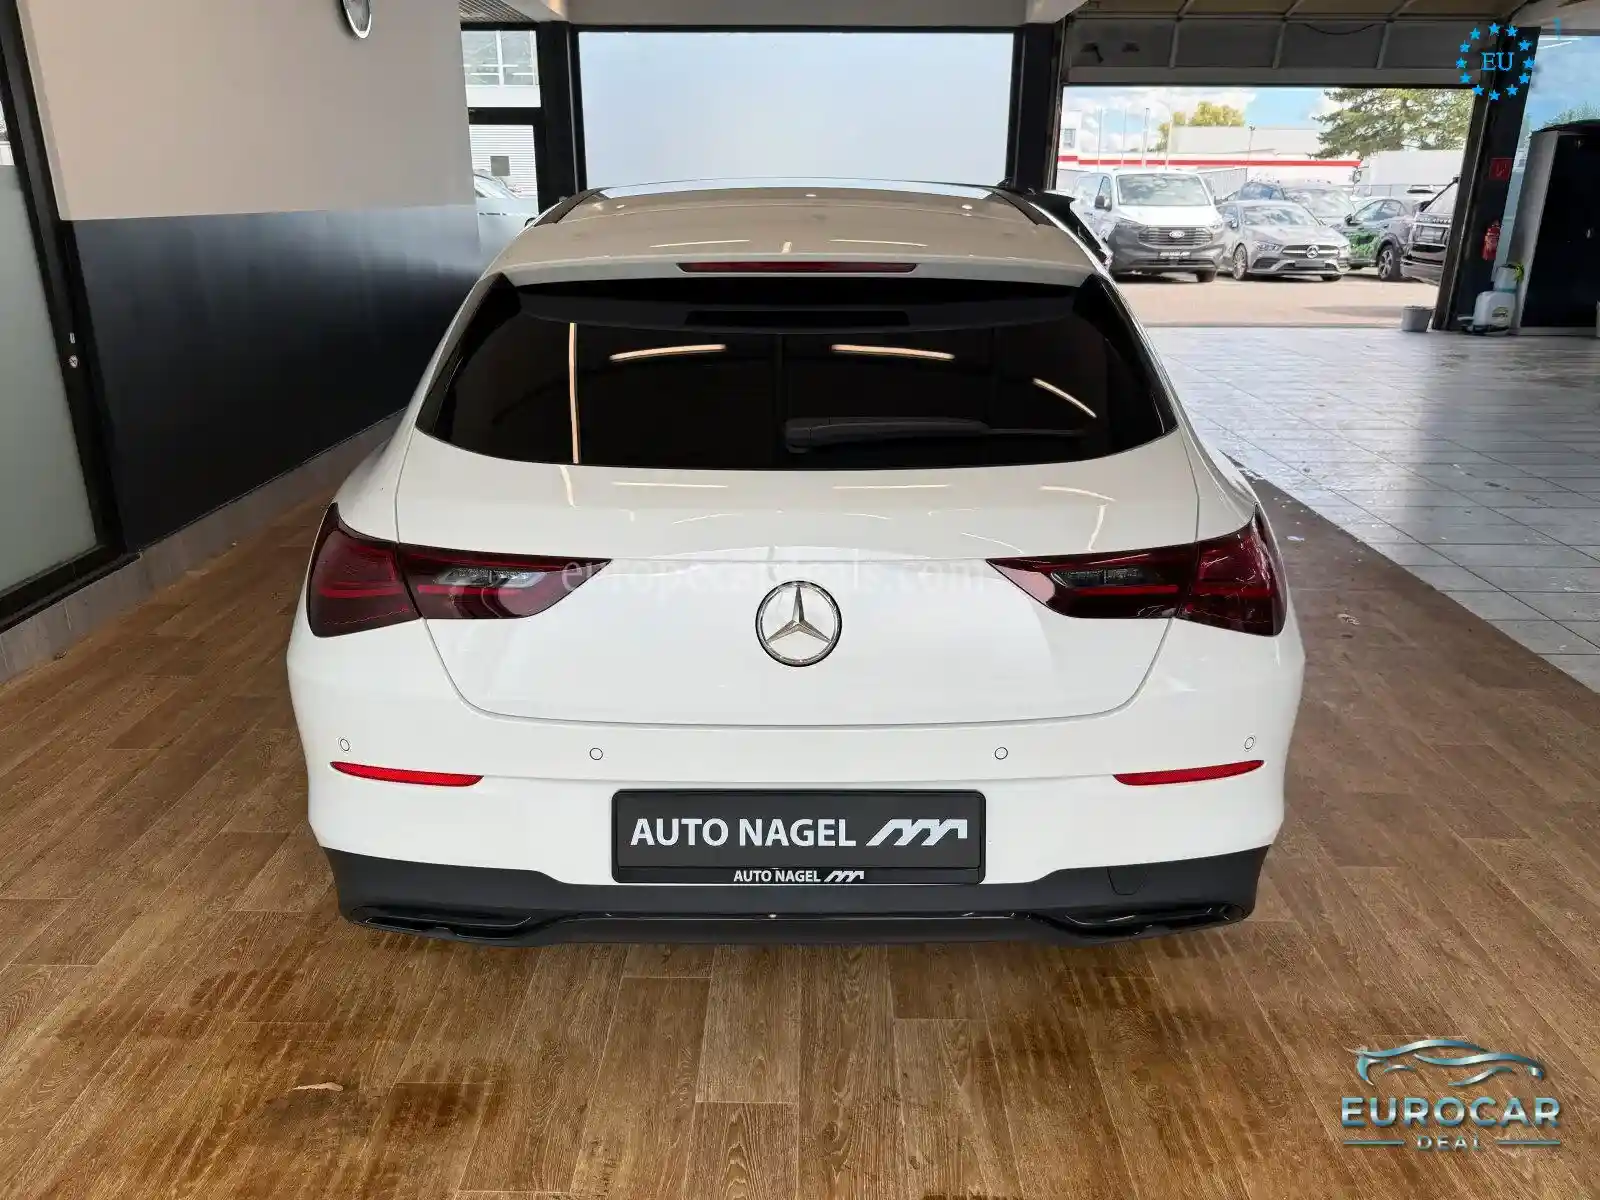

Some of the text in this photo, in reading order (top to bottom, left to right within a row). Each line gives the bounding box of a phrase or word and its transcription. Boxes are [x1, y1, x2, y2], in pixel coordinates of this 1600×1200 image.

[630, 818, 857, 847] AUTO NAGEL
[733, 870, 821, 883] AUTO NAGEL
